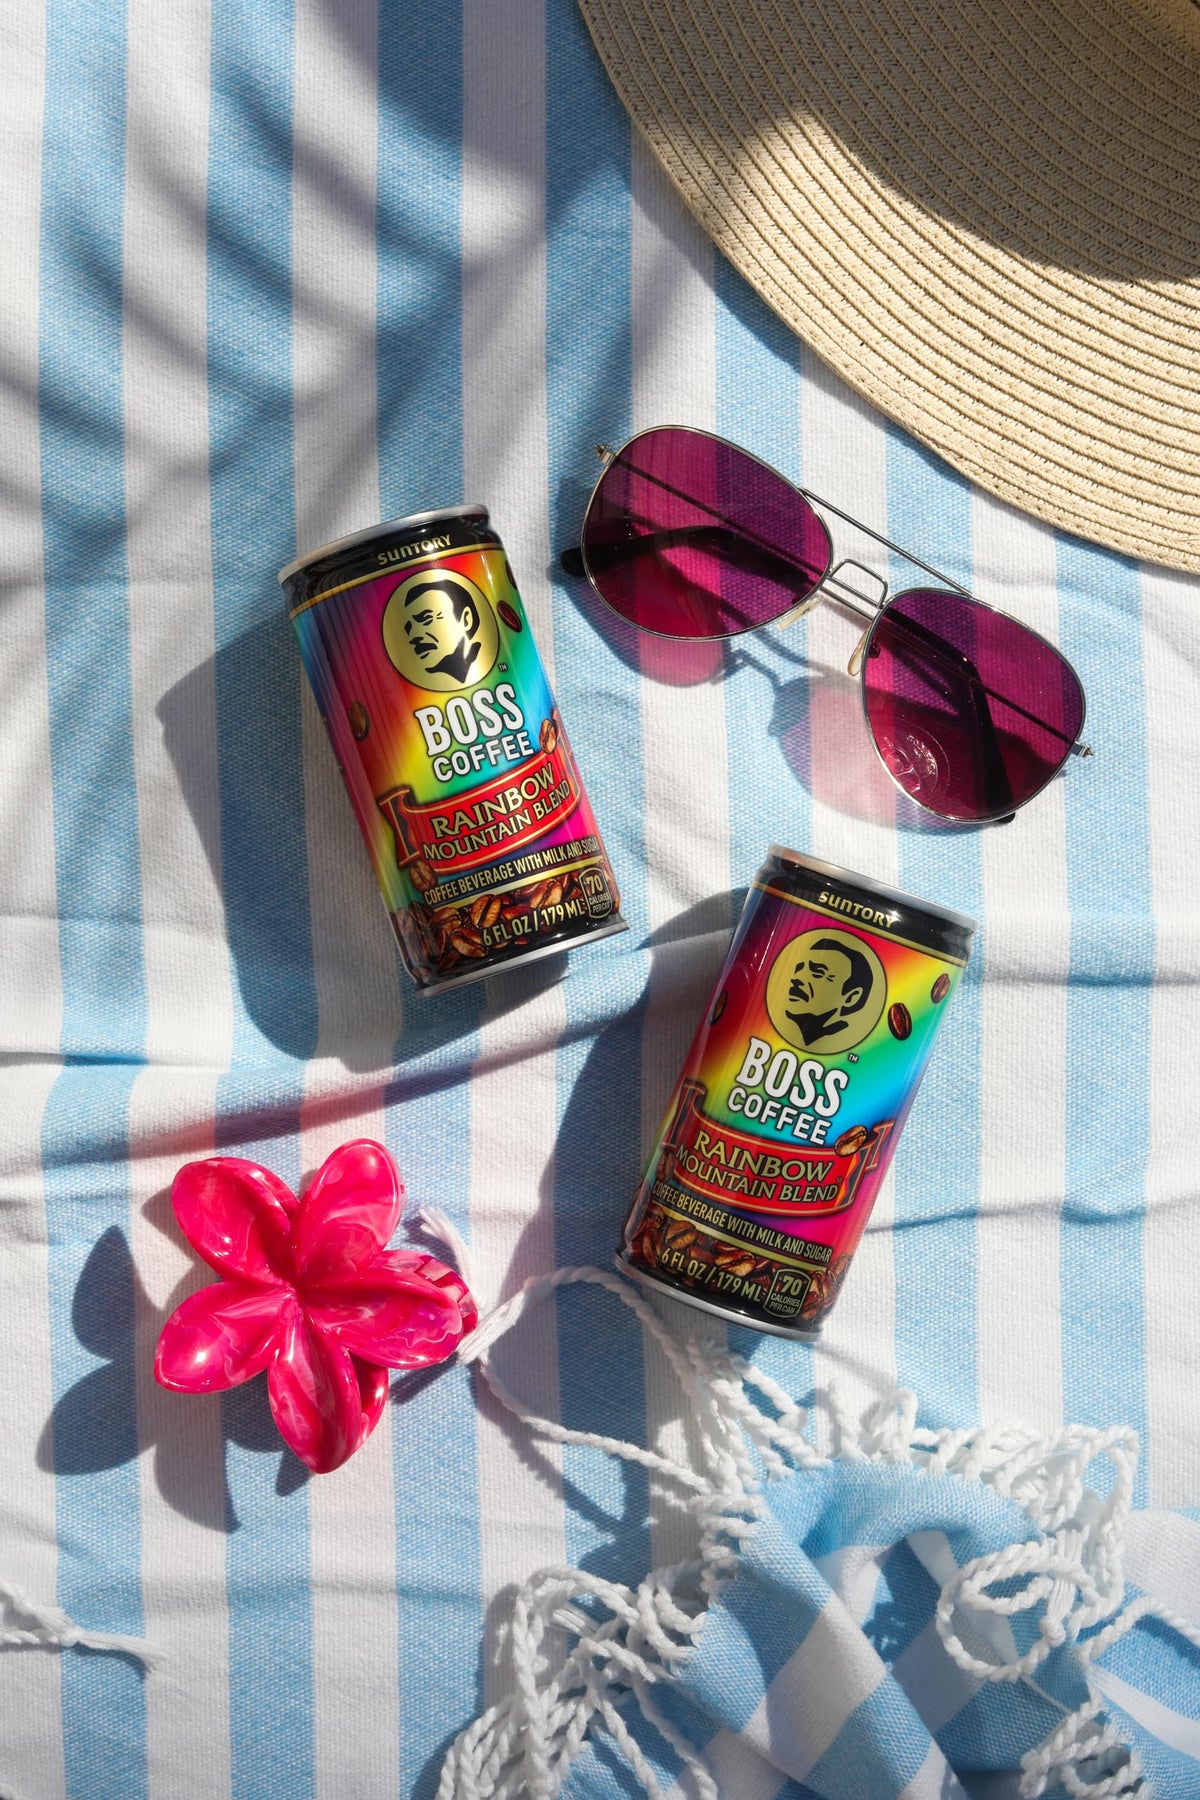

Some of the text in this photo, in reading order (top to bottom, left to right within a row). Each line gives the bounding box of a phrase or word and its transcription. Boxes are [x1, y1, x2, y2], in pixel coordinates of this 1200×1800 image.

[415, 683, 524, 757] BOSS
[432, 731, 535, 783] COFFEE
[423, 780, 570, 860] MOUNTAIN BLEND
[430, 762, 554, 840] RAINBOW
[424, 884, 461, 905] COFFEE
[459, 863, 515, 893] BEVERAGE
[514, 849, 544, 874] WITH
[542, 845, 567, 865] MILK
[566, 841, 582, 858] AND
[585, 875, 603, 894] 70
[483, 929, 491, 946] 6
[494, 923, 511, 942] FL
[512, 916, 532, 936] OZ
[541, 905, 564, 927] 179
[566, 898, 586, 918] ML
[735, 1037, 850, 1118] BOSS
[727, 1086, 831, 1146] COFFEE
[676, 1143, 839, 1203] MOUNTAIN BLEND
[693, 1131, 834, 1184] RAINBOW
[652, 1180, 832, 1263] COFFEE BEVERAGE WITH MILK AND SUGAR
[661, 1247, 669, 1264] 6
[670, 1253, 685, 1272] FL
[687, 1259, 706, 1280] OZ
[716, 1270, 741, 1293] 179
[743, 1283, 762, 1302] ML
[770, 1292, 801, 1308] CALORIES
[781, 1275, 803, 1296] 70
